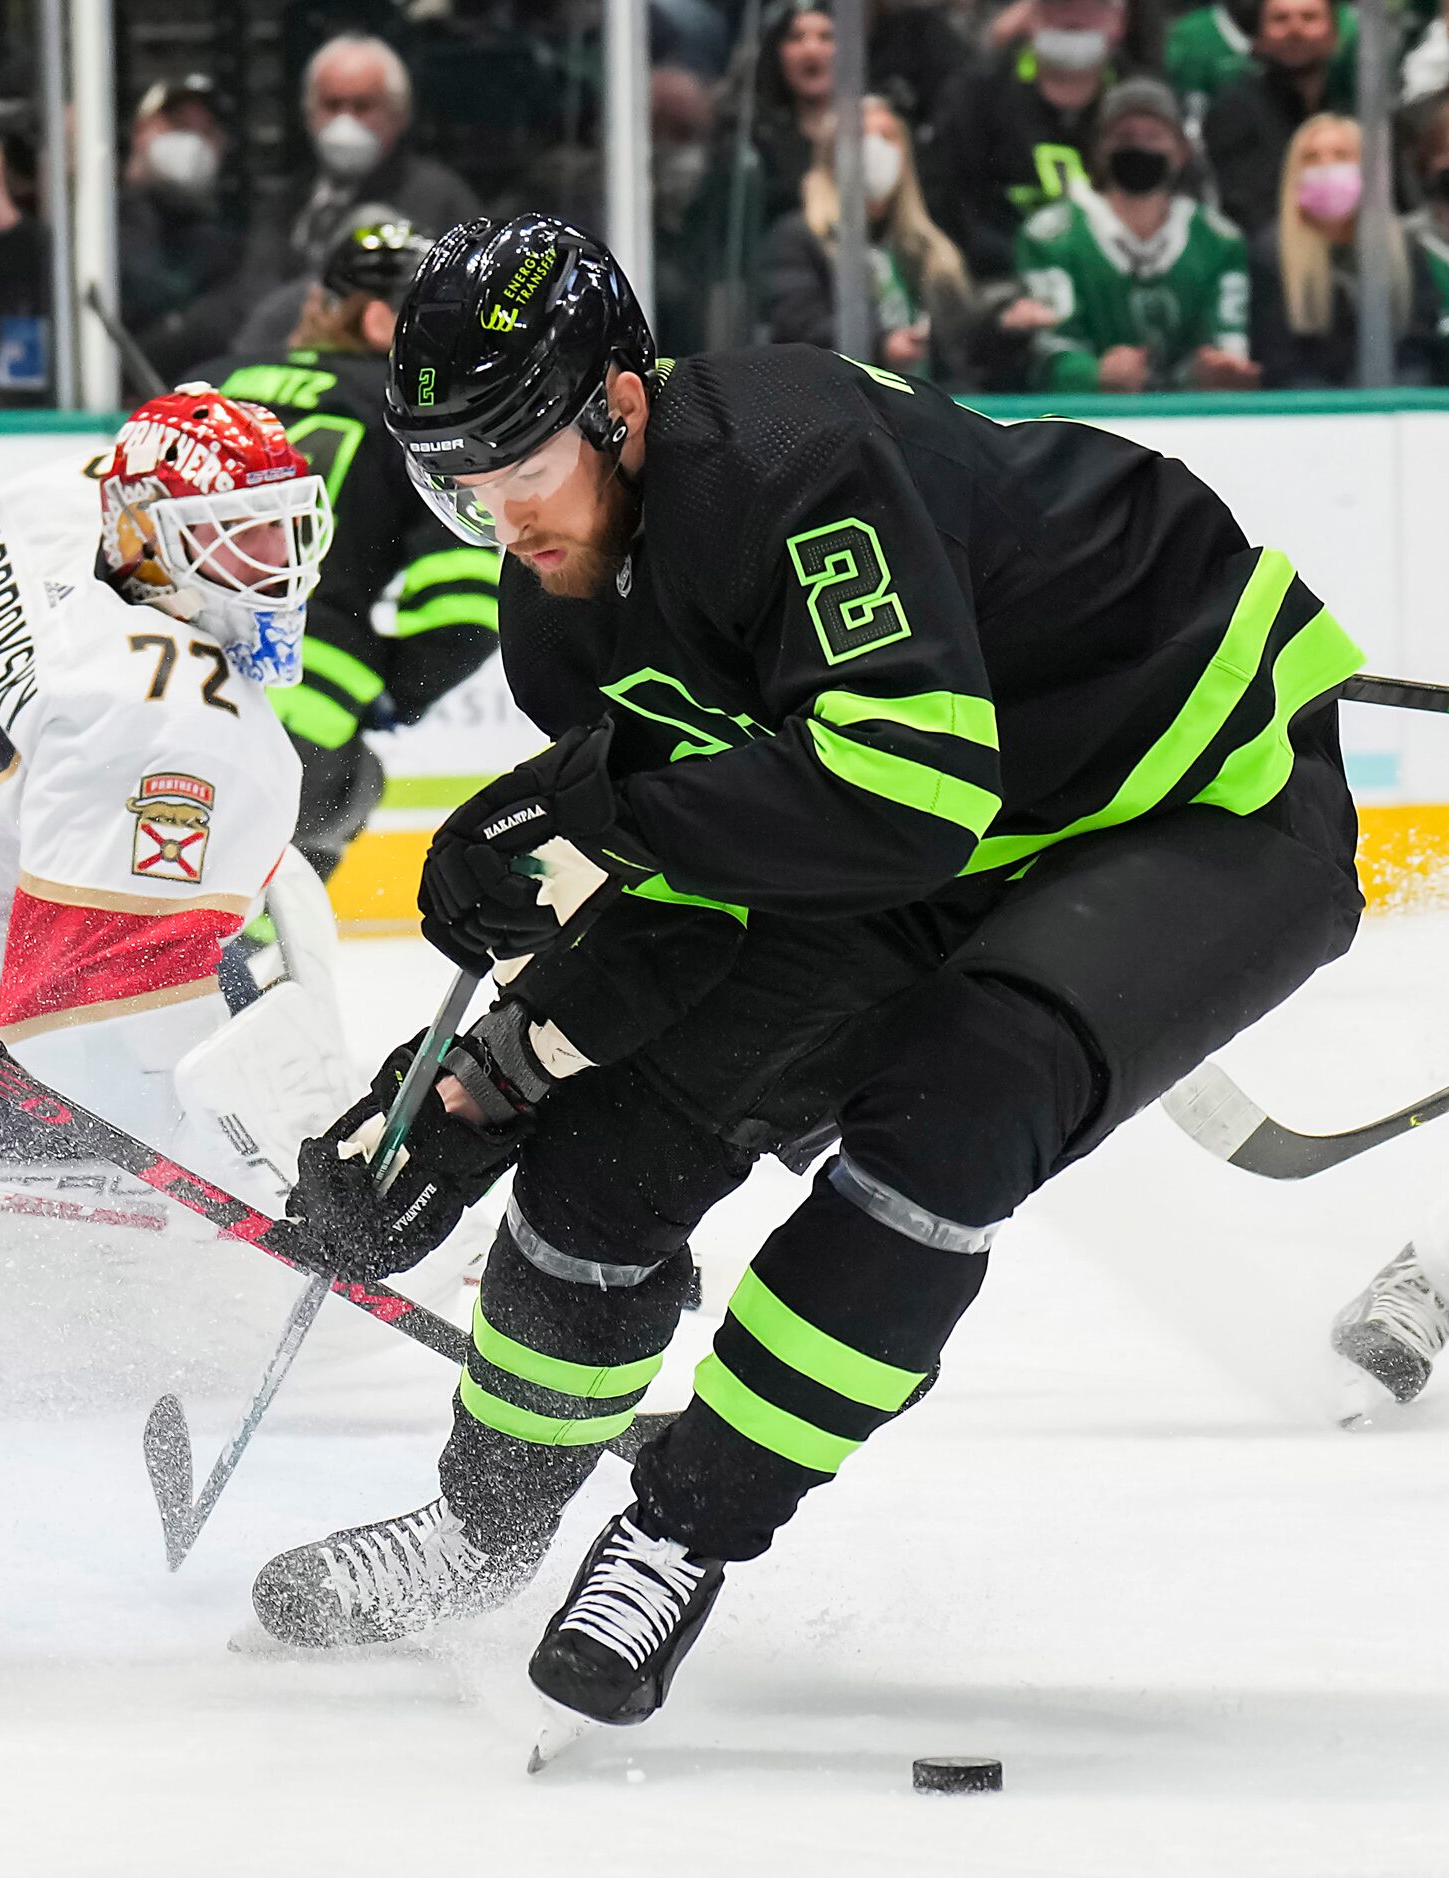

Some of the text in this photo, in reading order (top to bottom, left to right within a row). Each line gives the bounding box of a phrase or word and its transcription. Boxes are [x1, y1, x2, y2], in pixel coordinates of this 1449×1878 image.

[503, 250, 540, 299] ENERGY
[418, 367, 436, 407] 2
[786, 517, 912, 666] 2
[127, 633, 239, 718] 72
[150, 779, 206, 799] PANTHERS
[483, 804, 547, 840] HAKANPAA
